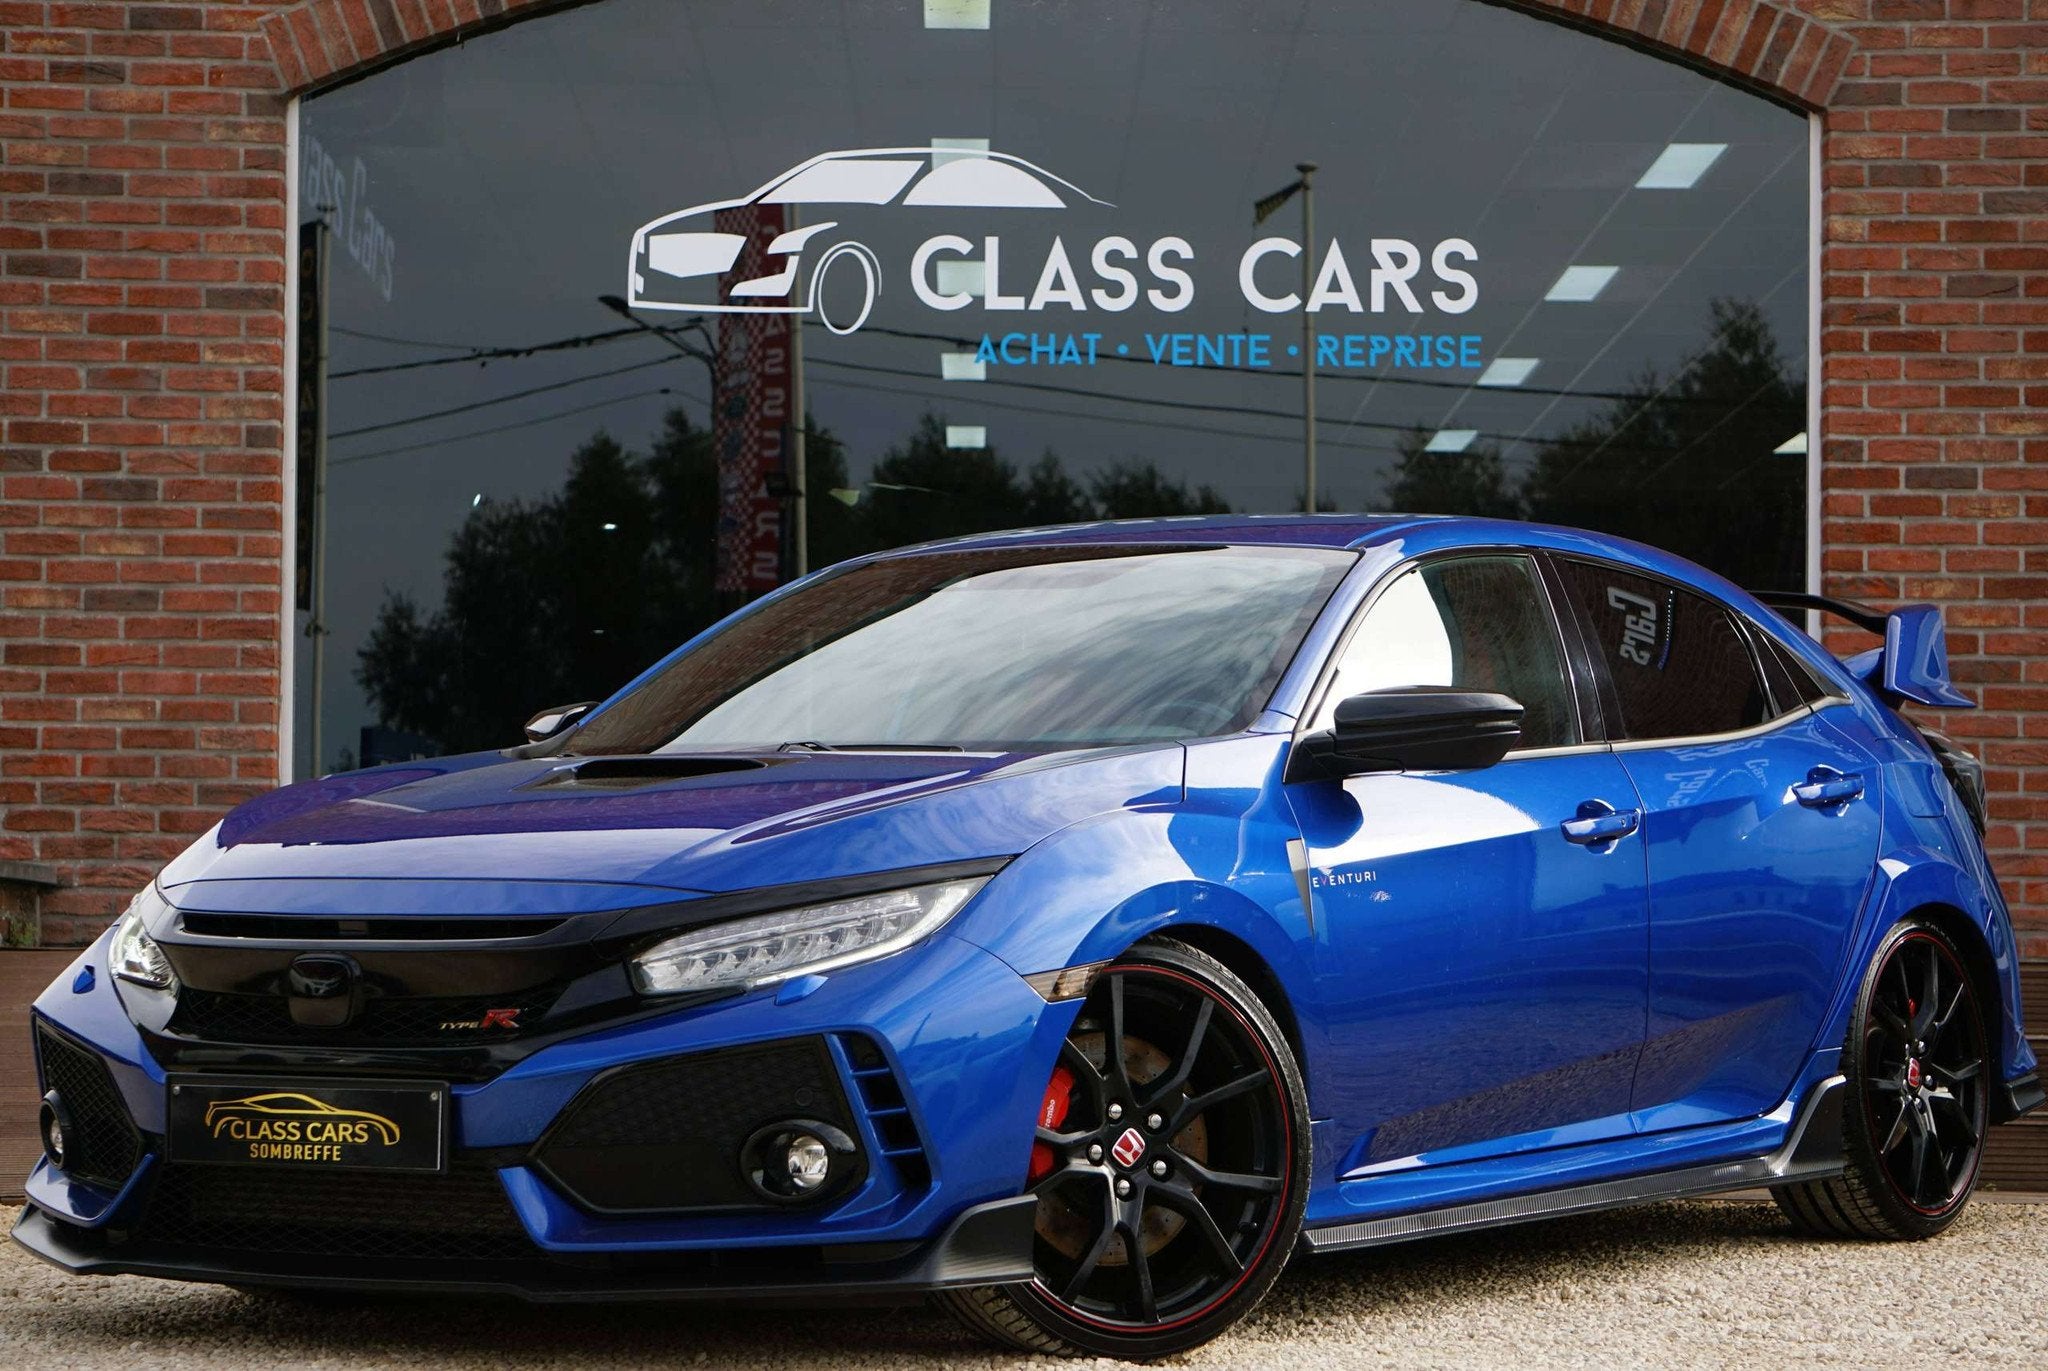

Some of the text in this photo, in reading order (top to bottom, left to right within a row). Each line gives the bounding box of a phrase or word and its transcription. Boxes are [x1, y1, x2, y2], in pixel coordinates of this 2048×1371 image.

[910, 234, 1479, 314] CLASS CARS
[974, 332, 1482, 368] ACHAT VENTE REPRISE
[1312, 870, 1377, 888] EVENTURI
[440, 1008, 520, 1031] TYPE R
[1044, 1098, 1056, 1127] rembo
[230, 1121, 369, 1143] CLASS CARS
[250, 1143, 342, 1161] SOMBREFFE
